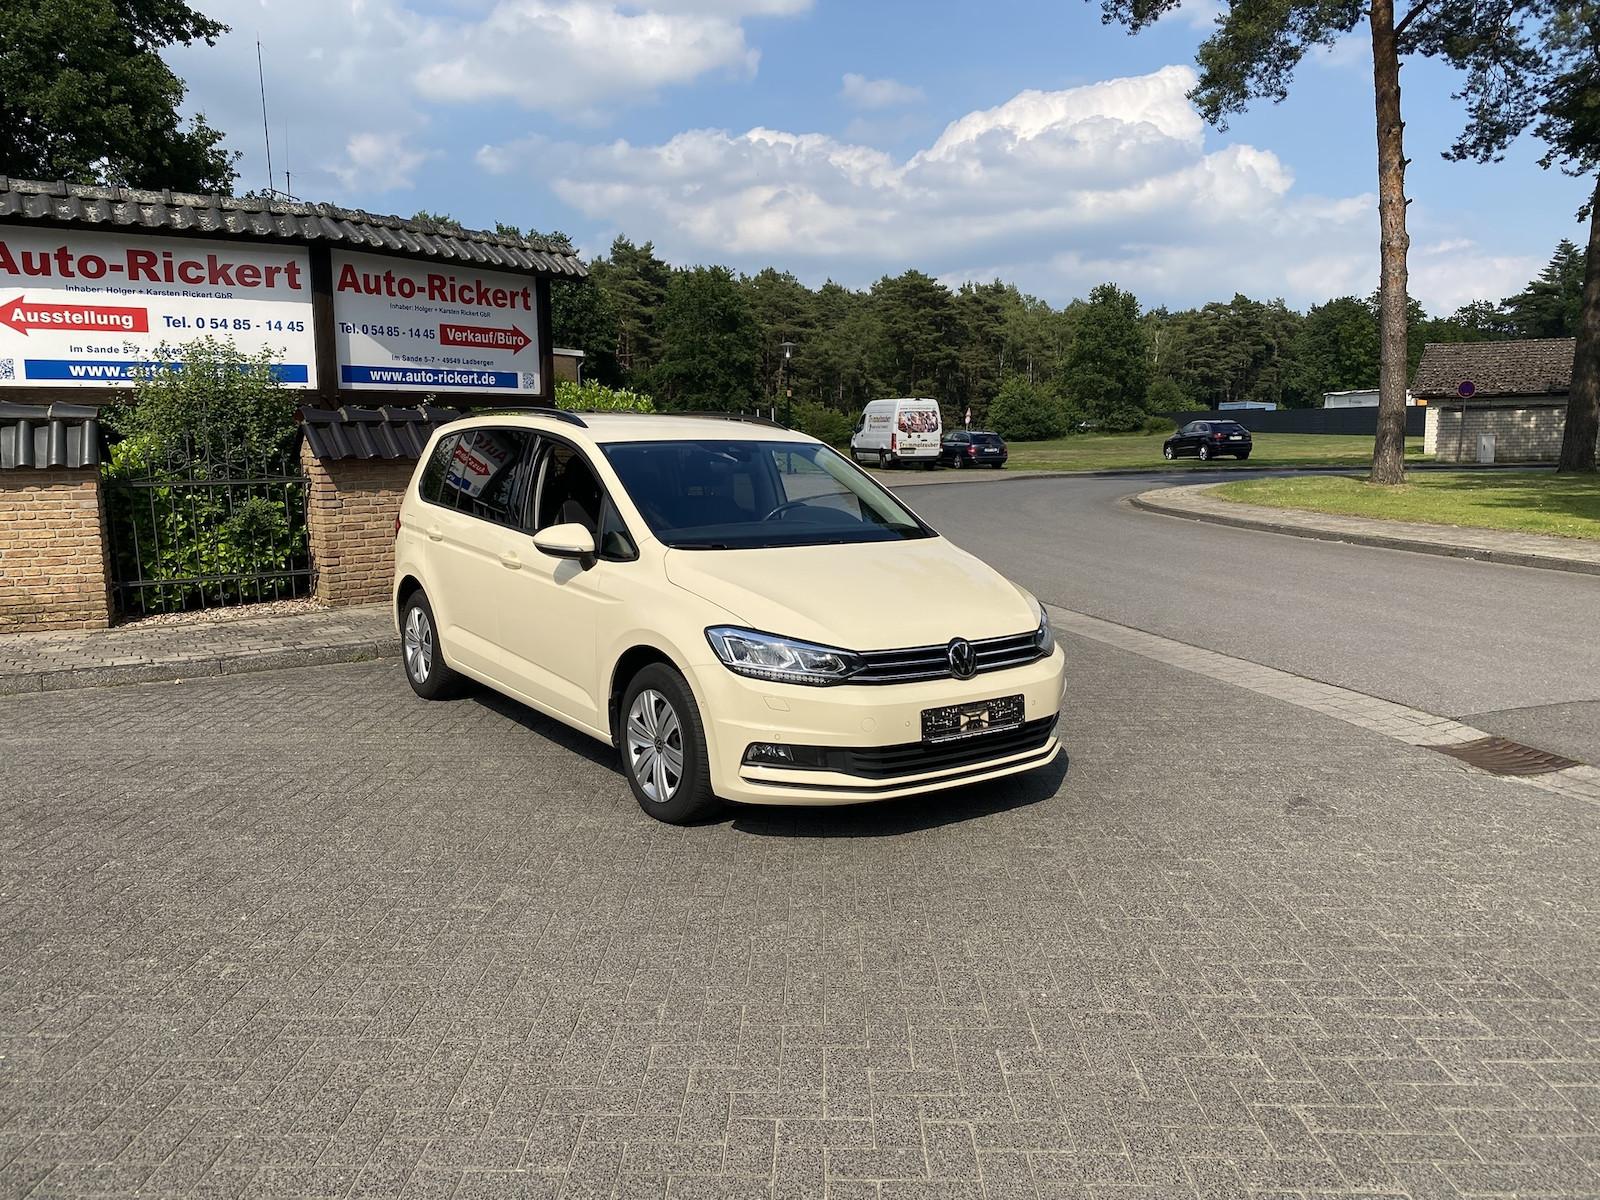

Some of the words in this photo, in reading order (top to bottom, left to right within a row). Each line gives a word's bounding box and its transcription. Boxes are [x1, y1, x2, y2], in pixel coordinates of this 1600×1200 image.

[0, 240, 302, 290] Auto-Rickert
[65, 284, 104, 294] Inhaber:
[106, 287, 136, 296] Holger
[146, 288, 180, 297] Karsten
[182, 291, 212, 299] Rickert
[337, 264, 532, 311] Auto-Rickert
[11, 307, 134, 328] Ausstellung
[389, 303, 413, 312] Inhaber:
[414, 304, 434, 314] Holger
[439, 307, 460, 316] Karsten
[460, 309, 480, 317] Rickert
[163, 315, 191, 329] Tel.
[196, 317, 205, 329] 0
[210, 317, 228, 330] 54
[233, 318, 251, 331] 85
[266, 319, 282, 332] 14
[287, 320, 304, 333] 45
[339, 322, 359, 334] Tel.
[362, 324, 369, 335] 0
[371, 325, 385, 336] 54
[388, 326, 400, 337] 85
[409, 328, 420, 339] 14
[423, 329, 435, 340] 45
[447, 328, 524, 346] Verkauf/Büro
[70, 345, 83, 353] Im
[86, 345, 119, 354] Sande
[402, 355, 422, 363] Sande
[462, 358, 494, 367] Ladbergen
[370, 370, 496, 385] www.auto-rickert.de
